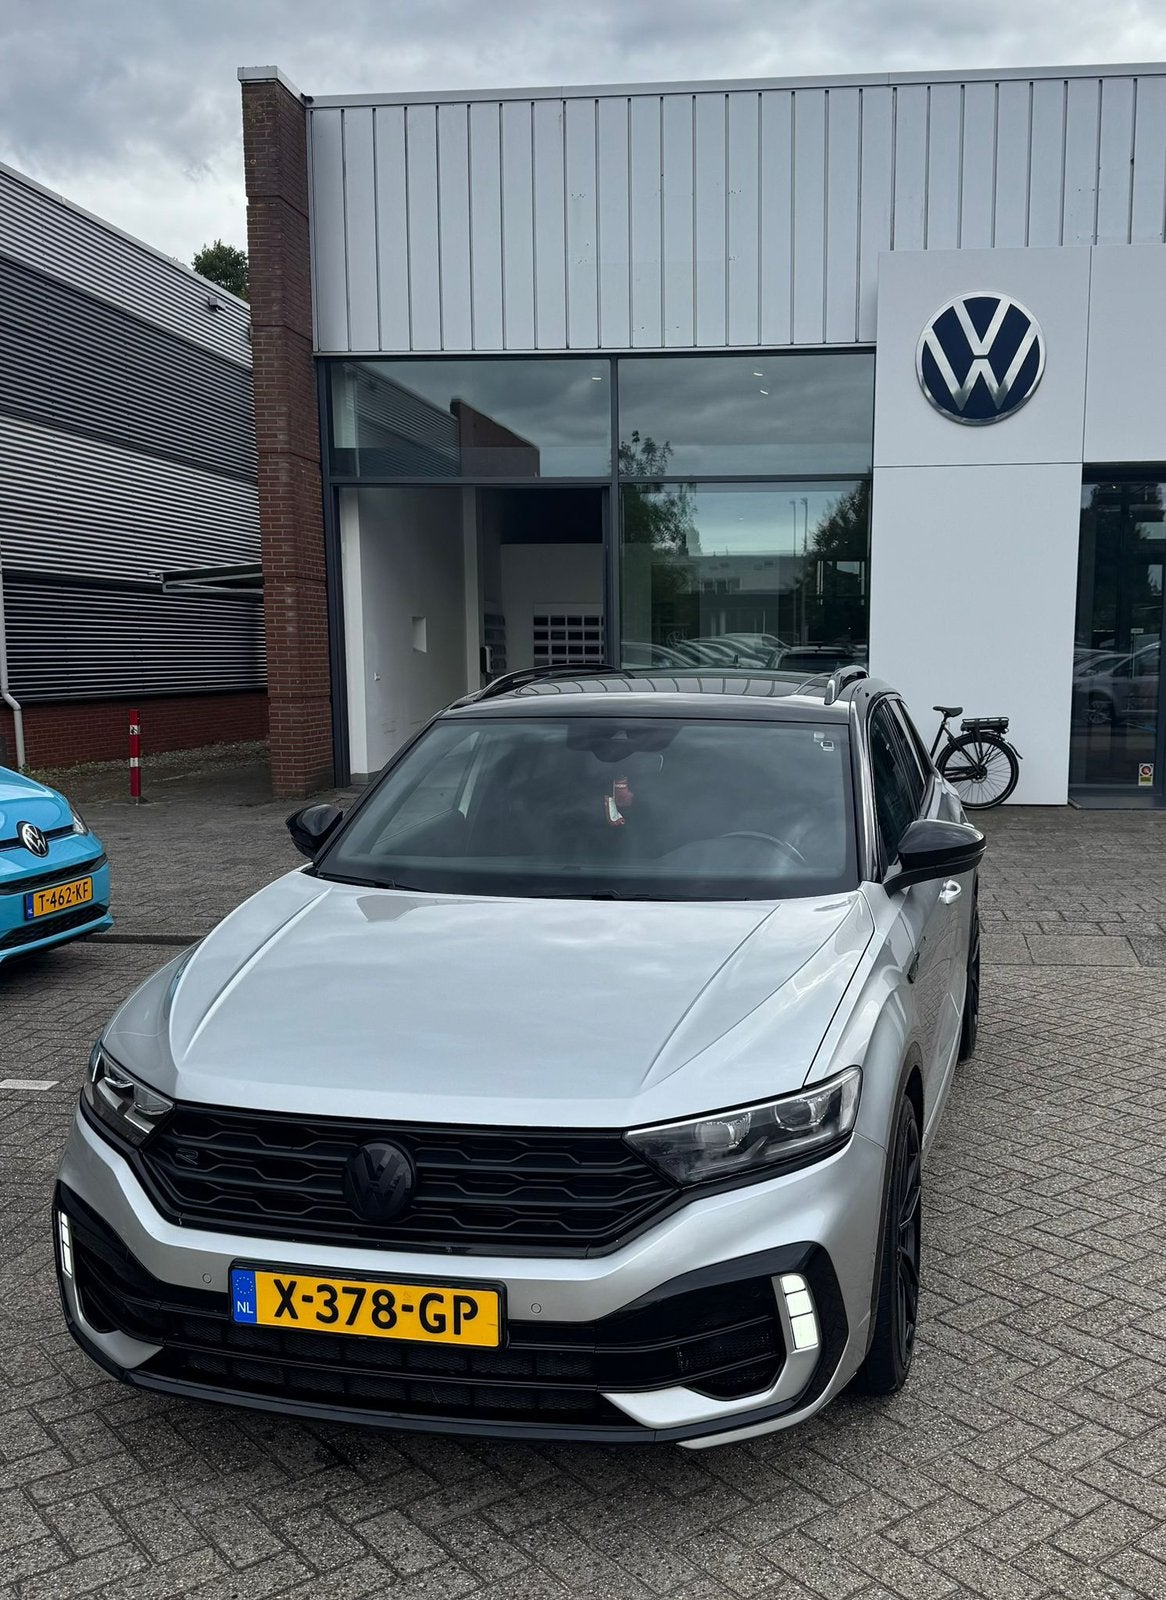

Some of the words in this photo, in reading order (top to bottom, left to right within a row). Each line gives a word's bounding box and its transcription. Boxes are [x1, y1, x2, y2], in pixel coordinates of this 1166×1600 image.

[38, 881, 89, 912] T-462-KF
[237, 1300, 254, 1314] NL
[273, 1278, 479, 1336] X-378-GP
